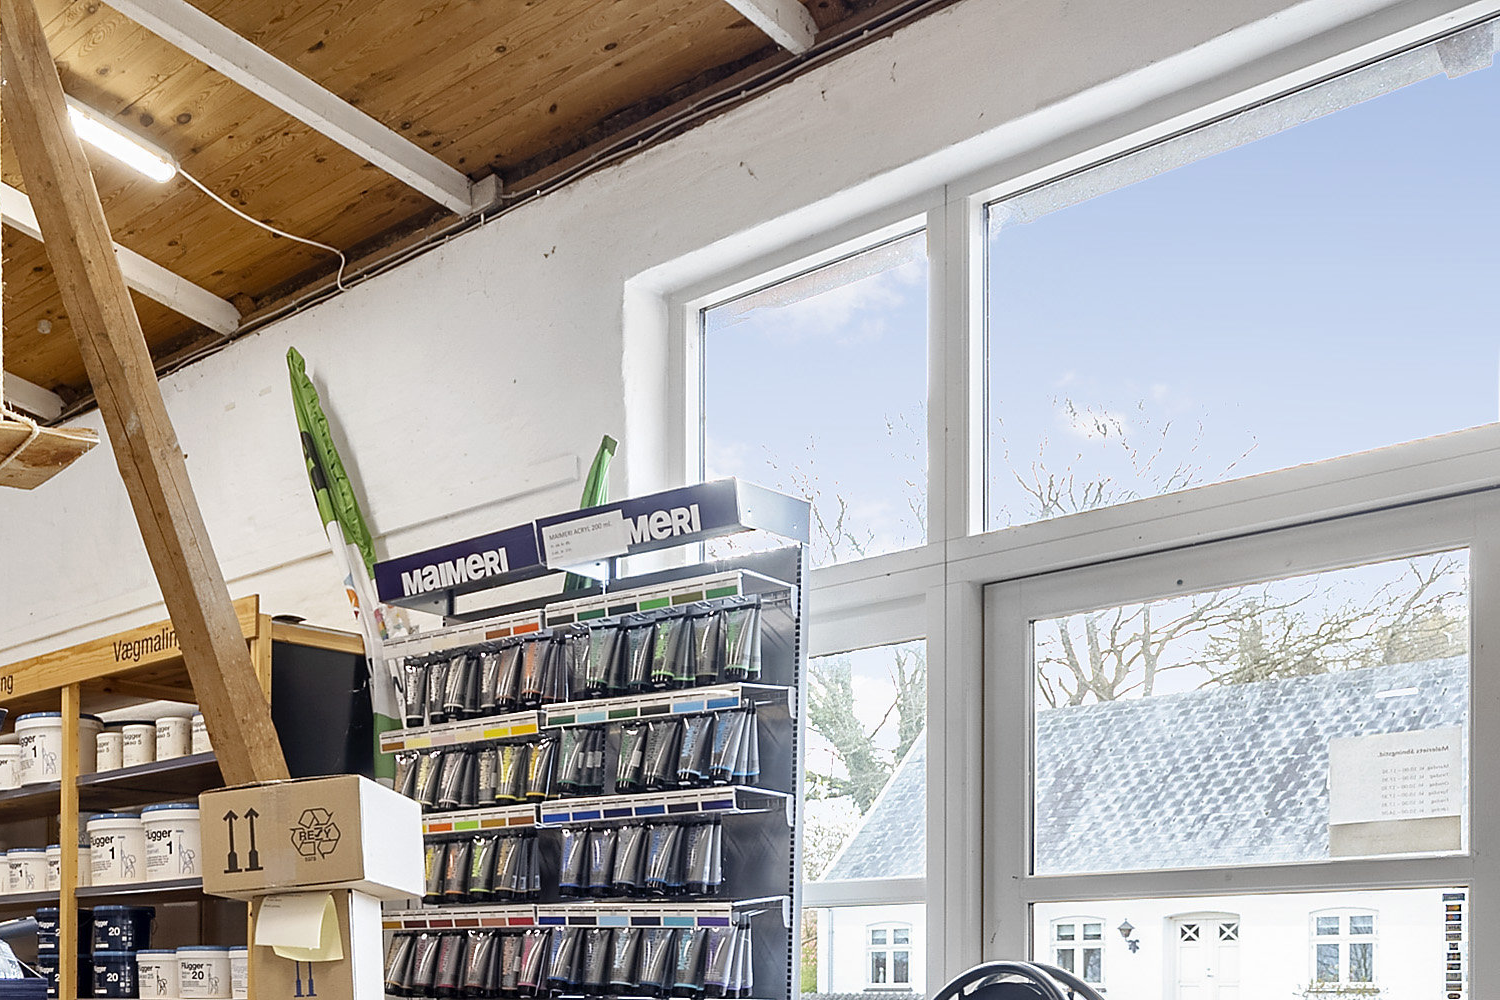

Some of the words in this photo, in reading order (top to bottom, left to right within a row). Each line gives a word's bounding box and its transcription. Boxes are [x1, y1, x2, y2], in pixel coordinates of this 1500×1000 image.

[113, 627, 183, 663] Vægmalin
[108, 846, 115, 860] 1
[166, 840, 173, 855] 1
[108, 926, 121, 936] 20
[106, 972, 119, 982] 20
[191, 970, 205, 980] 20
